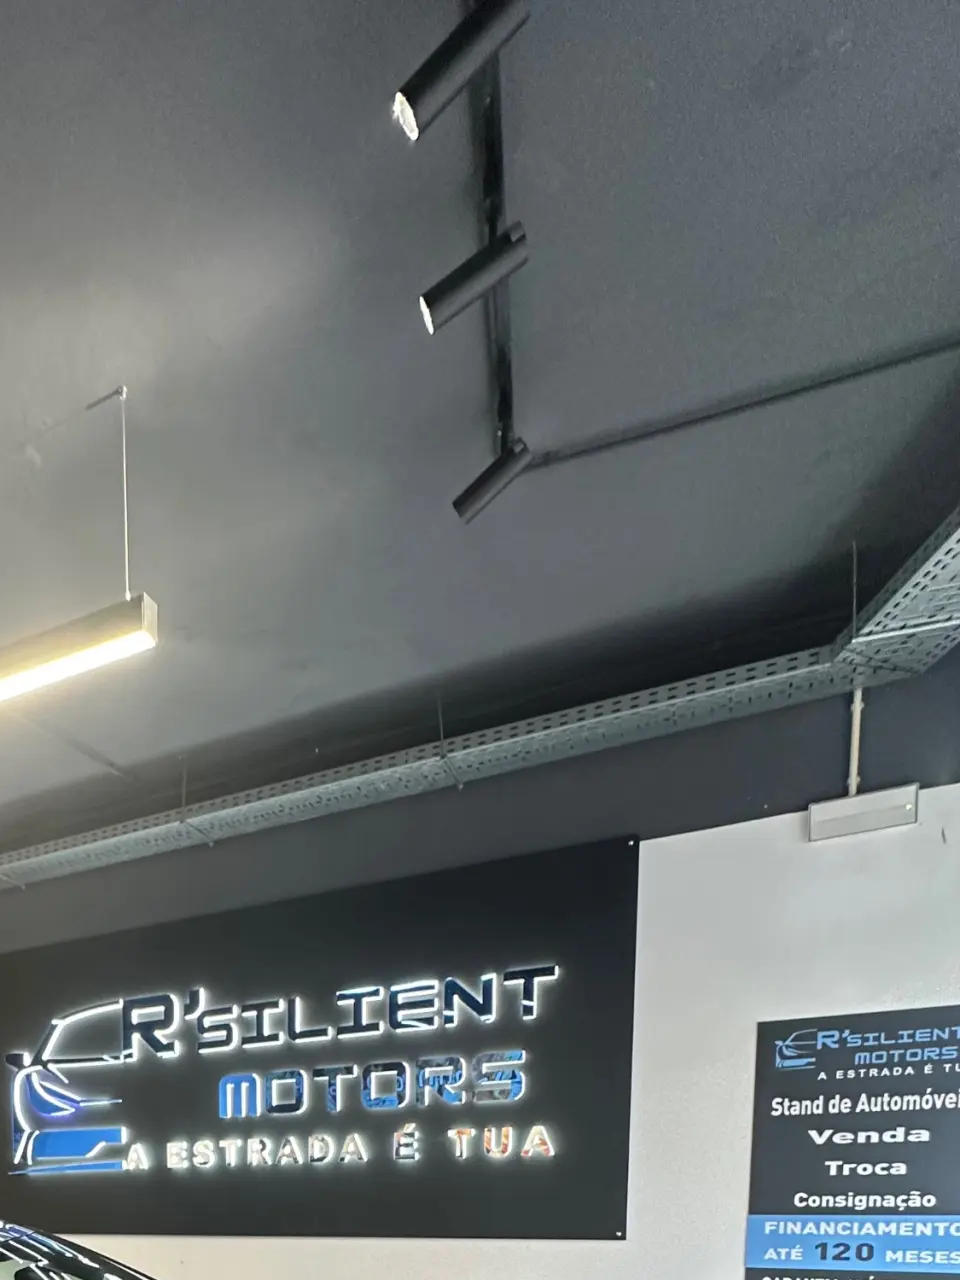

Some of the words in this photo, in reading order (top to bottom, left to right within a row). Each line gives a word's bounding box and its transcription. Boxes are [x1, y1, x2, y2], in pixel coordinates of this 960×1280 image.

[123, 963, 559, 1062] R'SILIENT
[855, 1045, 959, 1066] MOTORS
[219, 1048, 527, 1120] MOTORS
[817, 1071, 828, 1081] A
[835, 1067, 916, 1081] ESTRADA
[771, 1095, 824, 1117] Stand
[828, 1094, 852, 1114] de
[808, 1126, 931, 1145] Venda
[126, 1143, 150, 1170] A
[166, 1132, 369, 1170] ESTRADA
[393, 1123, 420, 1162] É
[447, 1125, 557, 1160] TUA
[825, 1160, 908, 1176] Troca
[793, 1191, 937, 1211] Consignação
[764, 1221, 960, 1237] FINANCIAMENTO
[763, 1245, 803, 1261] ATÉ
[815, 1242, 874, 1262] 120
[885, 1250, 960, 1265] MESES
